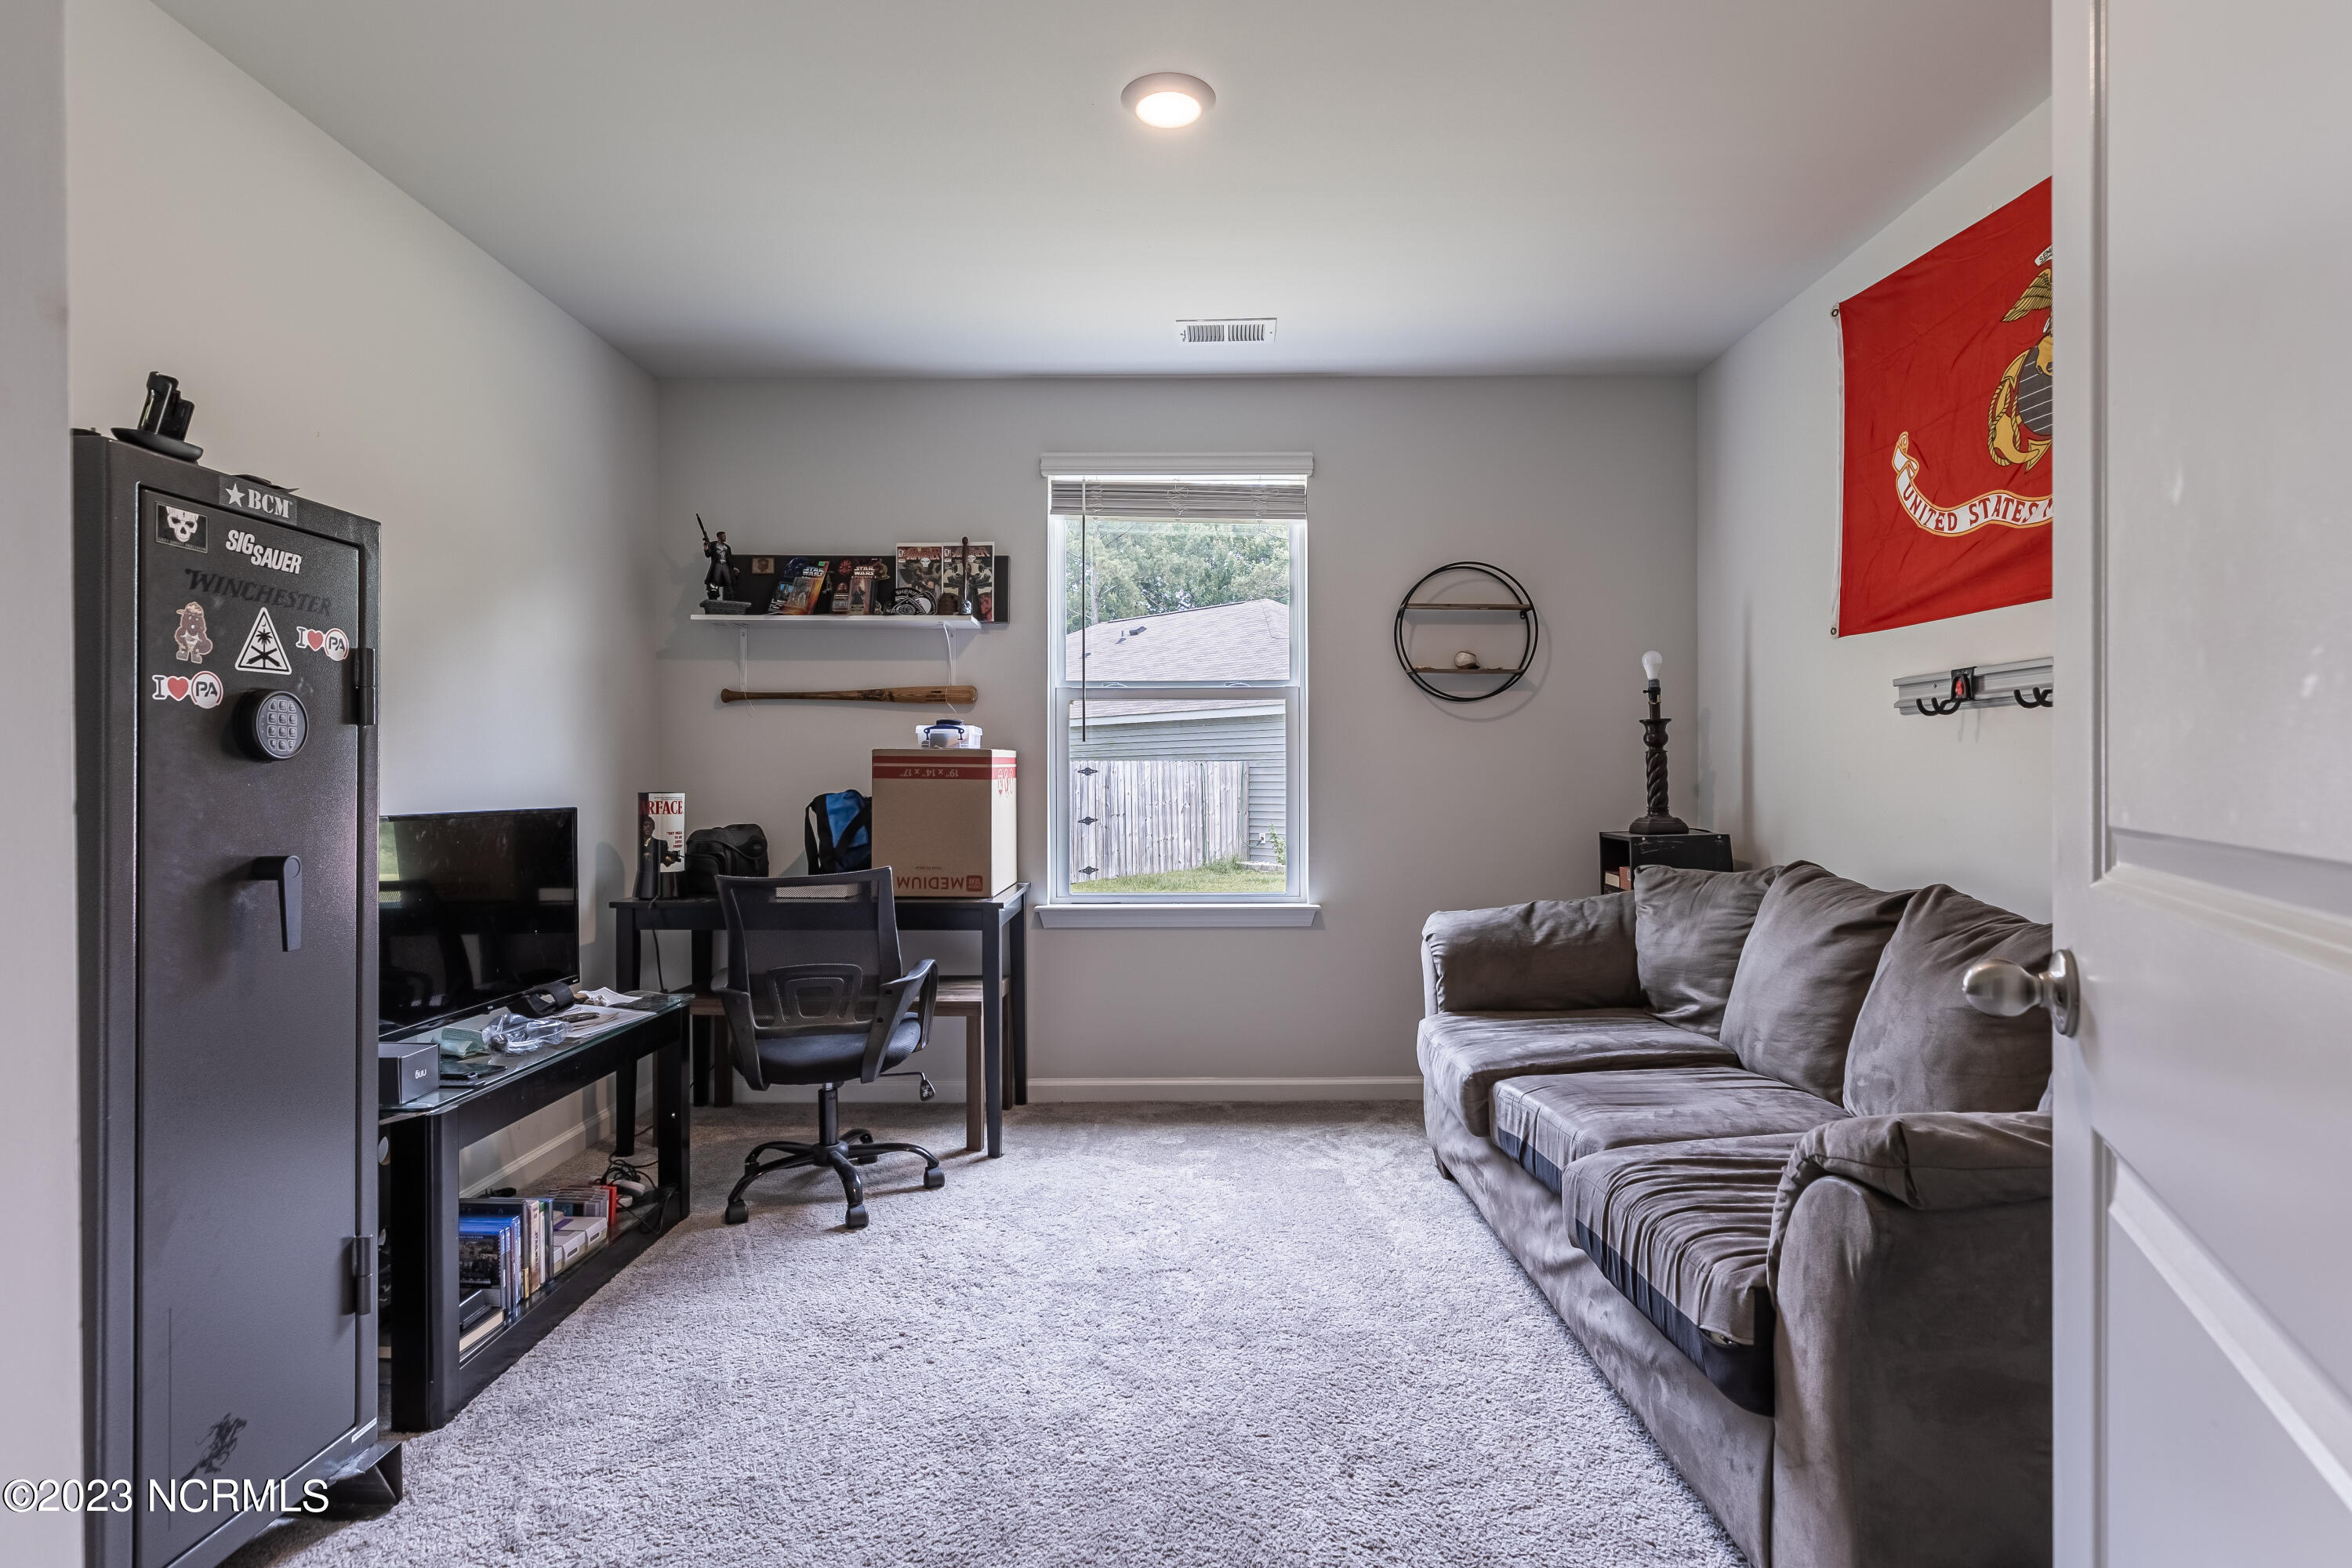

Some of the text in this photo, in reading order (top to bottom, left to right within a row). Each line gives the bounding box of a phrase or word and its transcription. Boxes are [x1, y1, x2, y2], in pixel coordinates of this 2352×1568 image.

[248, 489, 290, 519] BCM
[1903, 483, 1958, 532] UNITED
[1969, 495, 2039, 527] STATES
[225, 529, 255, 555] SIG
[251, 546, 302, 575] SAUER
[185, 568, 332, 615] WINCHESTER
[298, 627, 345, 652] I PA
[154, 676, 218, 698] I PA
[896, 877, 964, 890] MEDIUM
[415, 1069, 426, 1080] ring
